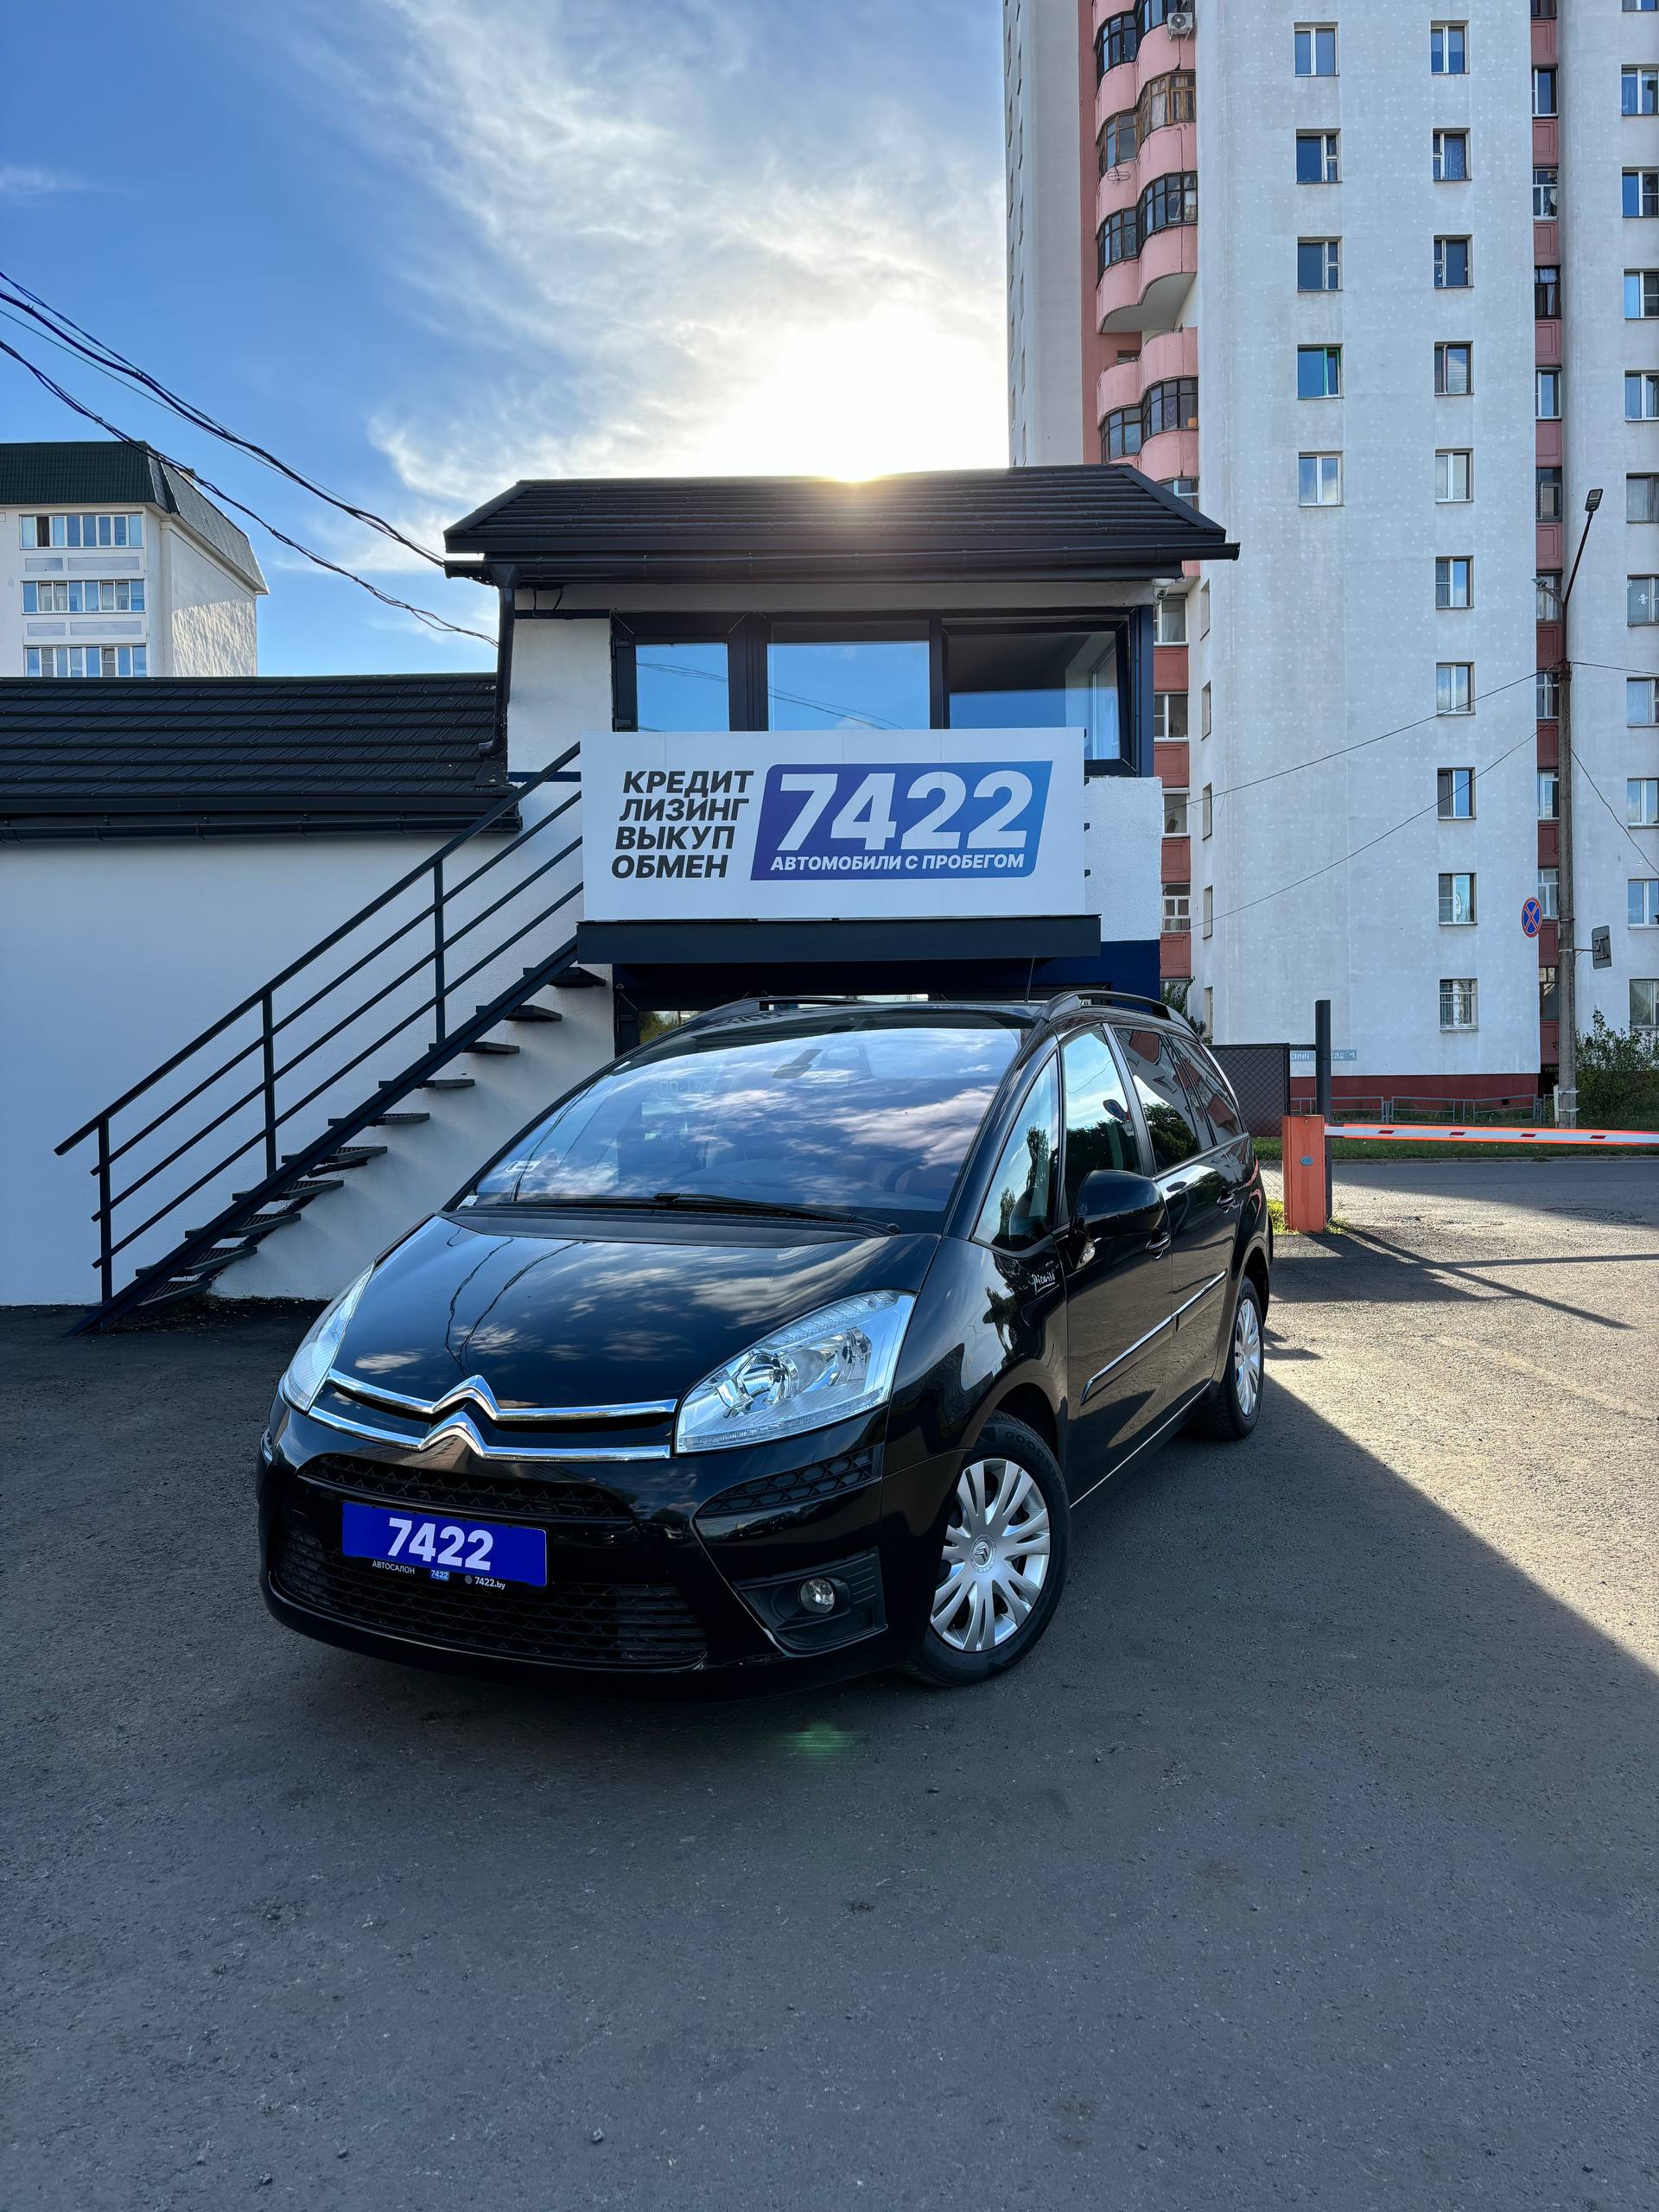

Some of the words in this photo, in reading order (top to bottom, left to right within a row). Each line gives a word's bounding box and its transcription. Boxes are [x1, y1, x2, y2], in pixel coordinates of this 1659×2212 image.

[622, 770, 754, 798] КРЕДИТ
[620, 798, 750, 822] ЛИЗИНГ
[777, 770, 1033, 851] 7422
[614, 826, 734, 850] ВЫКУП
[611, 855, 728, 879] ОБМЕН
[770, 855, 903, 872] АВТОМОБИЛИ
[905, 855, 918, 871] С
[921, 853, 1025, 871] ПРОБЕГОМ
[387, 1516, 493, 1571] 7422
[372, 1560, 416, 1574] АВТОСАЛОН
[430, 1569, 449, 1580] 7422
[474, 1576, 505, 1590] 7422.by
